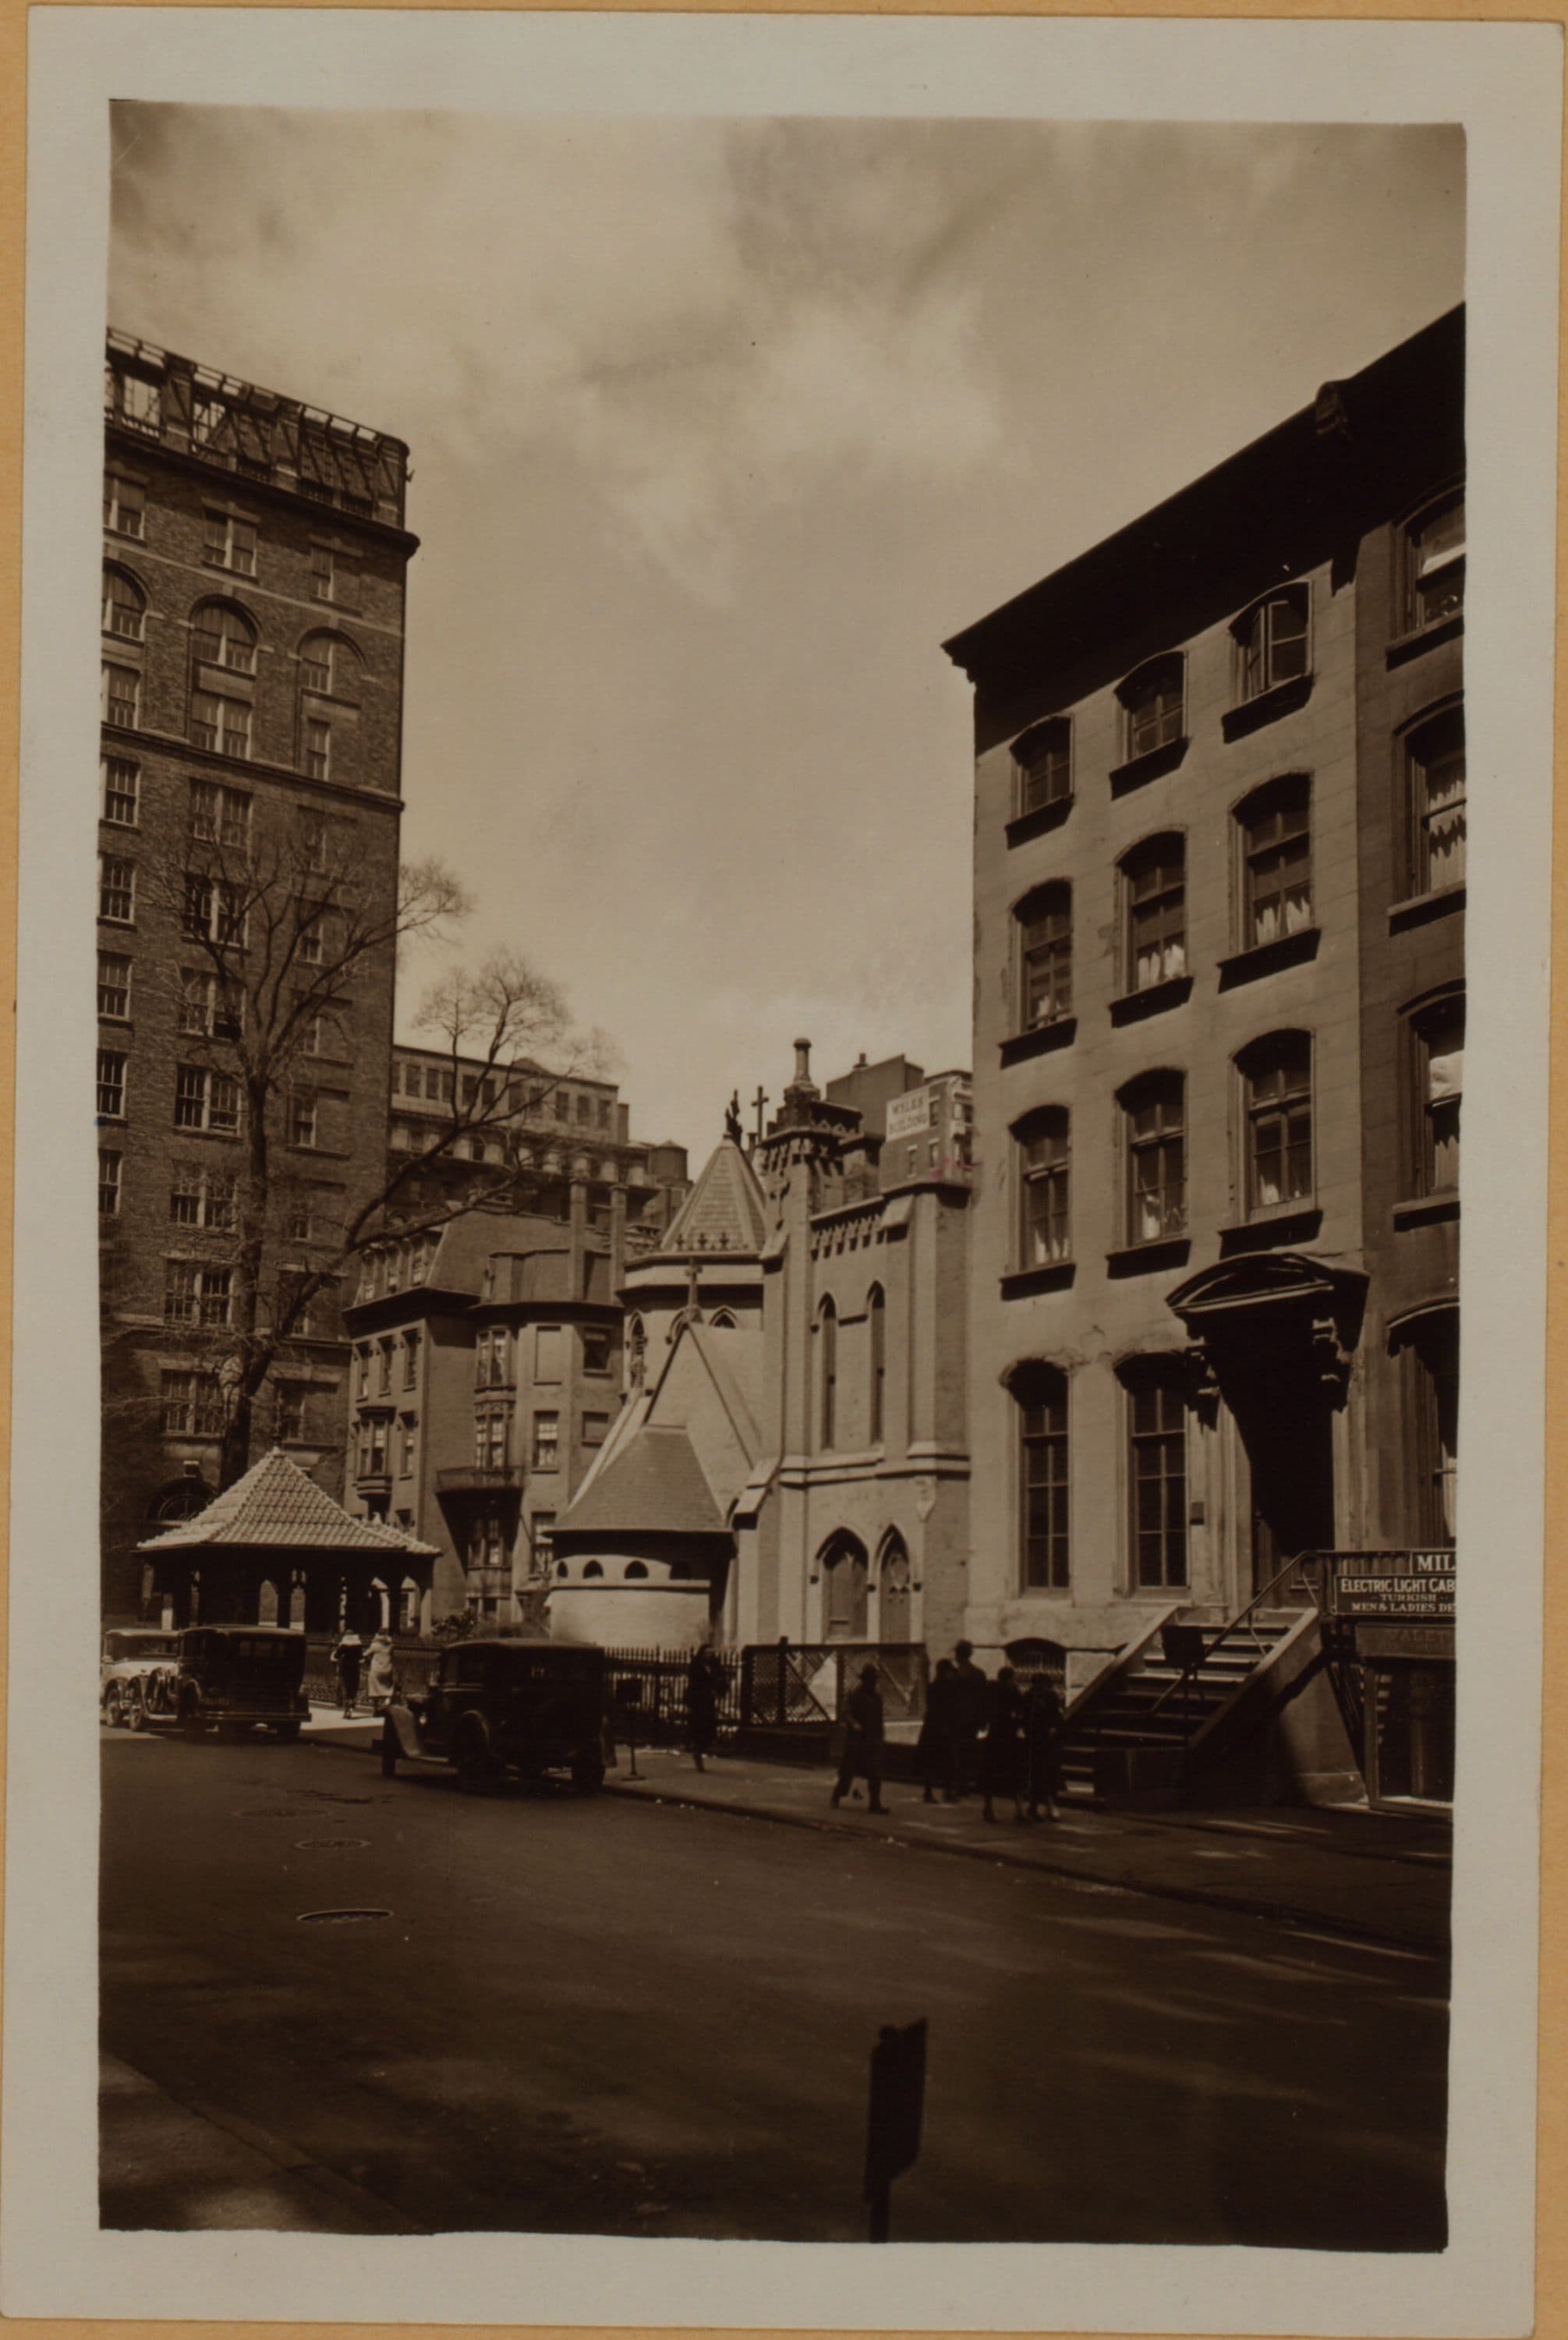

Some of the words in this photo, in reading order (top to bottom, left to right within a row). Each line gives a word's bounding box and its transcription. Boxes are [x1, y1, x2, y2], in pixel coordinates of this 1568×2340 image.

[1341, 1578, 1392, 1592] ELECTRIC
[1393, 1578, 1427, 1592] LIGHT
[1428, 1578, 1455, 1592] CAB
[1351, 1602, 1377, 1612] MEN
[1390, 1603, 1435, 1613] LADIES
